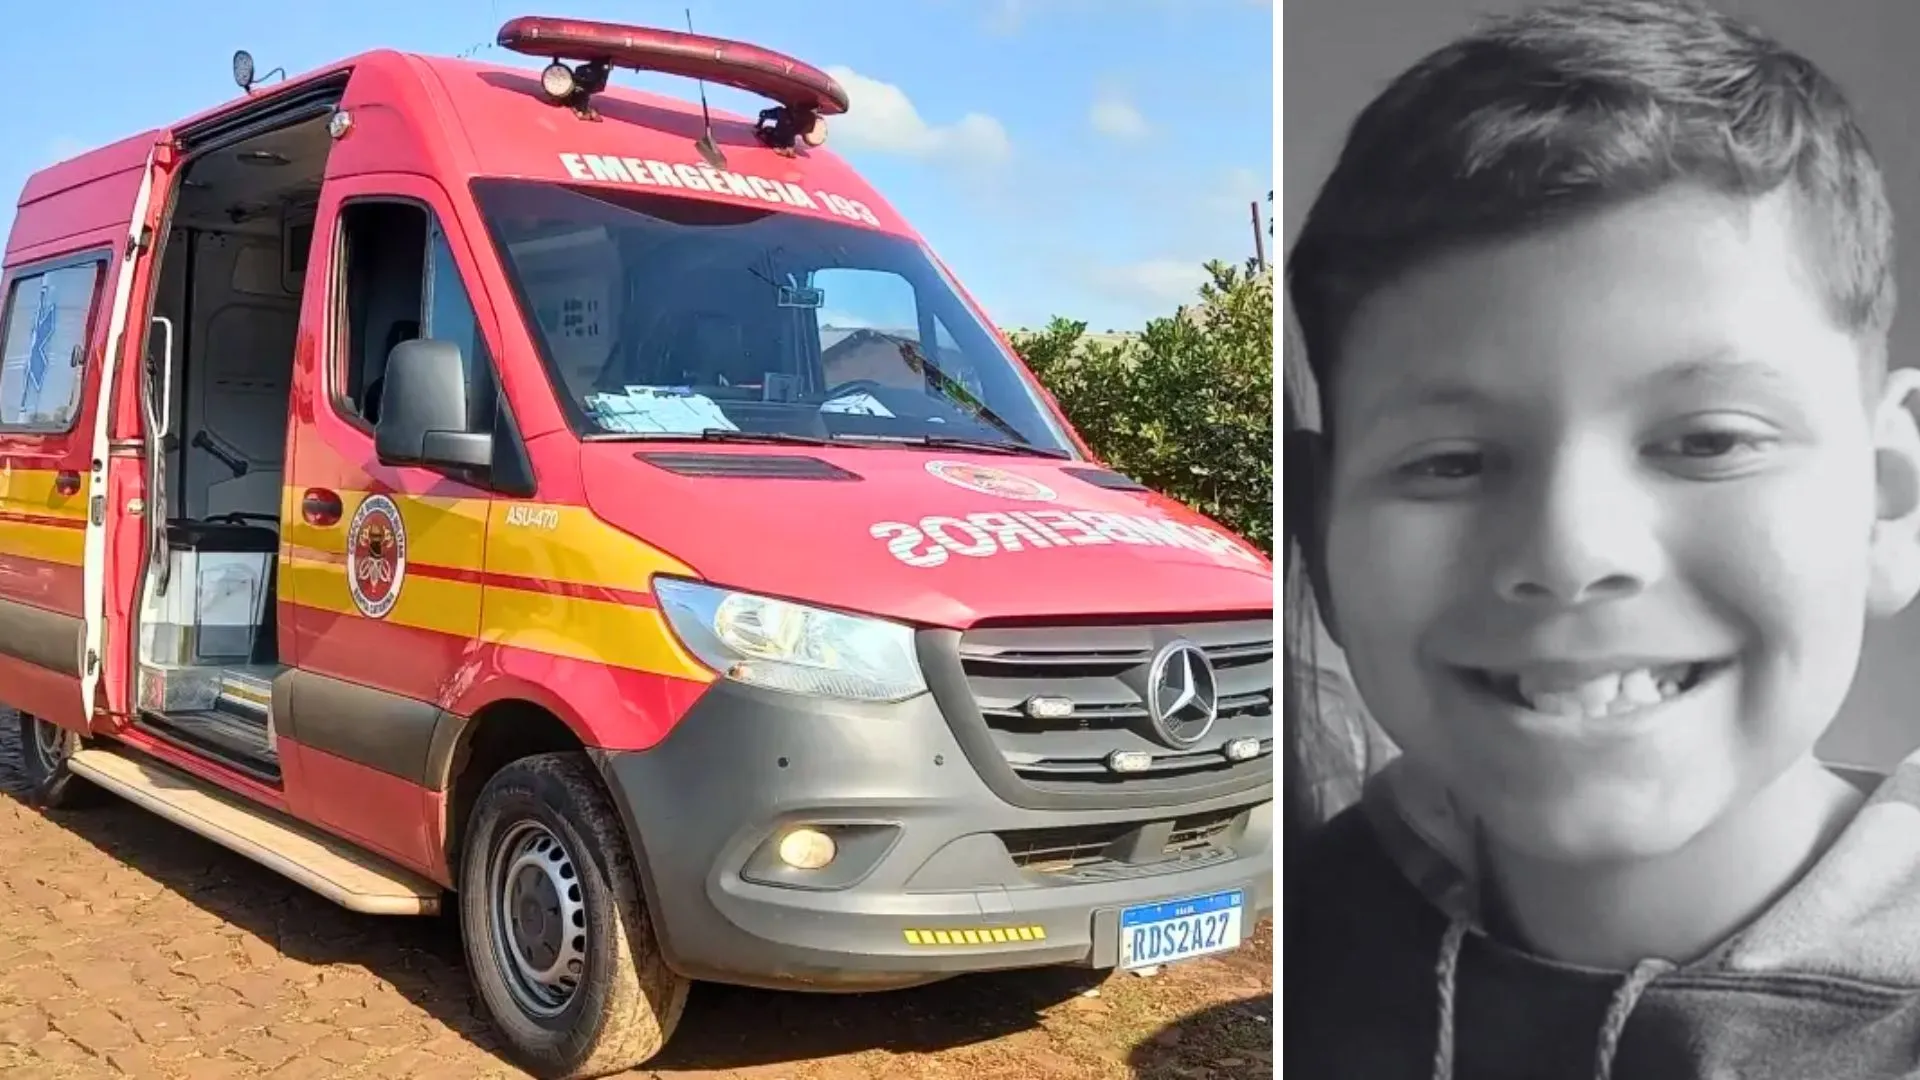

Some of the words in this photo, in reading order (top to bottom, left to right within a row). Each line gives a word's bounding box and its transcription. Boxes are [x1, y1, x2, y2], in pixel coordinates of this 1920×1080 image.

[559, 152, 819, 210] EMERGÊNCIA
[814, 190, 881, 230] 193
[505, 506, 559, 530] ASU-470
[1132, 912, 1230, 962] RDS2A27
